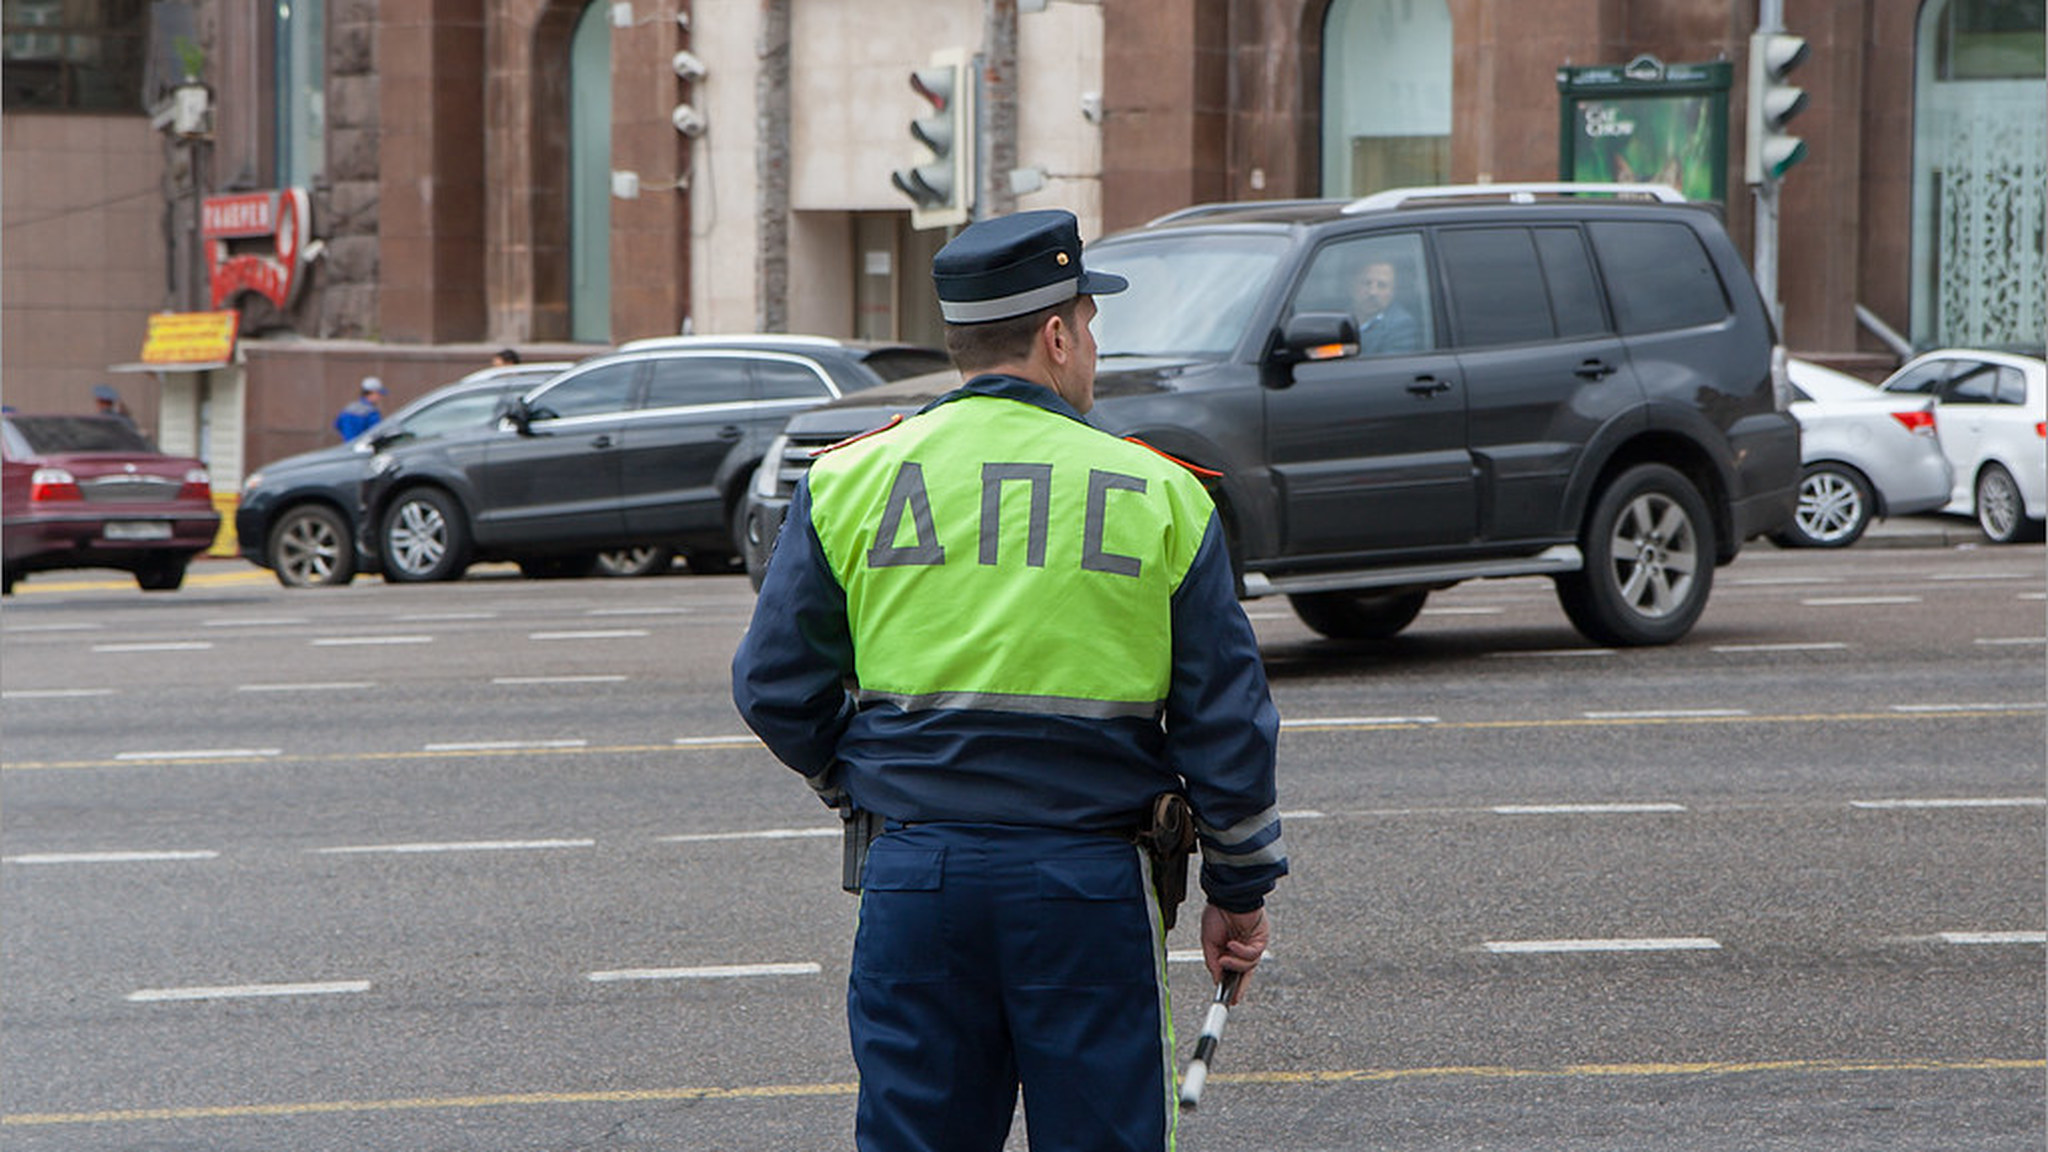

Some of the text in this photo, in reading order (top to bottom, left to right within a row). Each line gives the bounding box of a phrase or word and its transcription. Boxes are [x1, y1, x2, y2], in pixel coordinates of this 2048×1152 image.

[1585, 107, 1619, 122] CAT
[1585, 121, 1635, 137] CHOW
[867, 460, 1148, 578] ДПС
